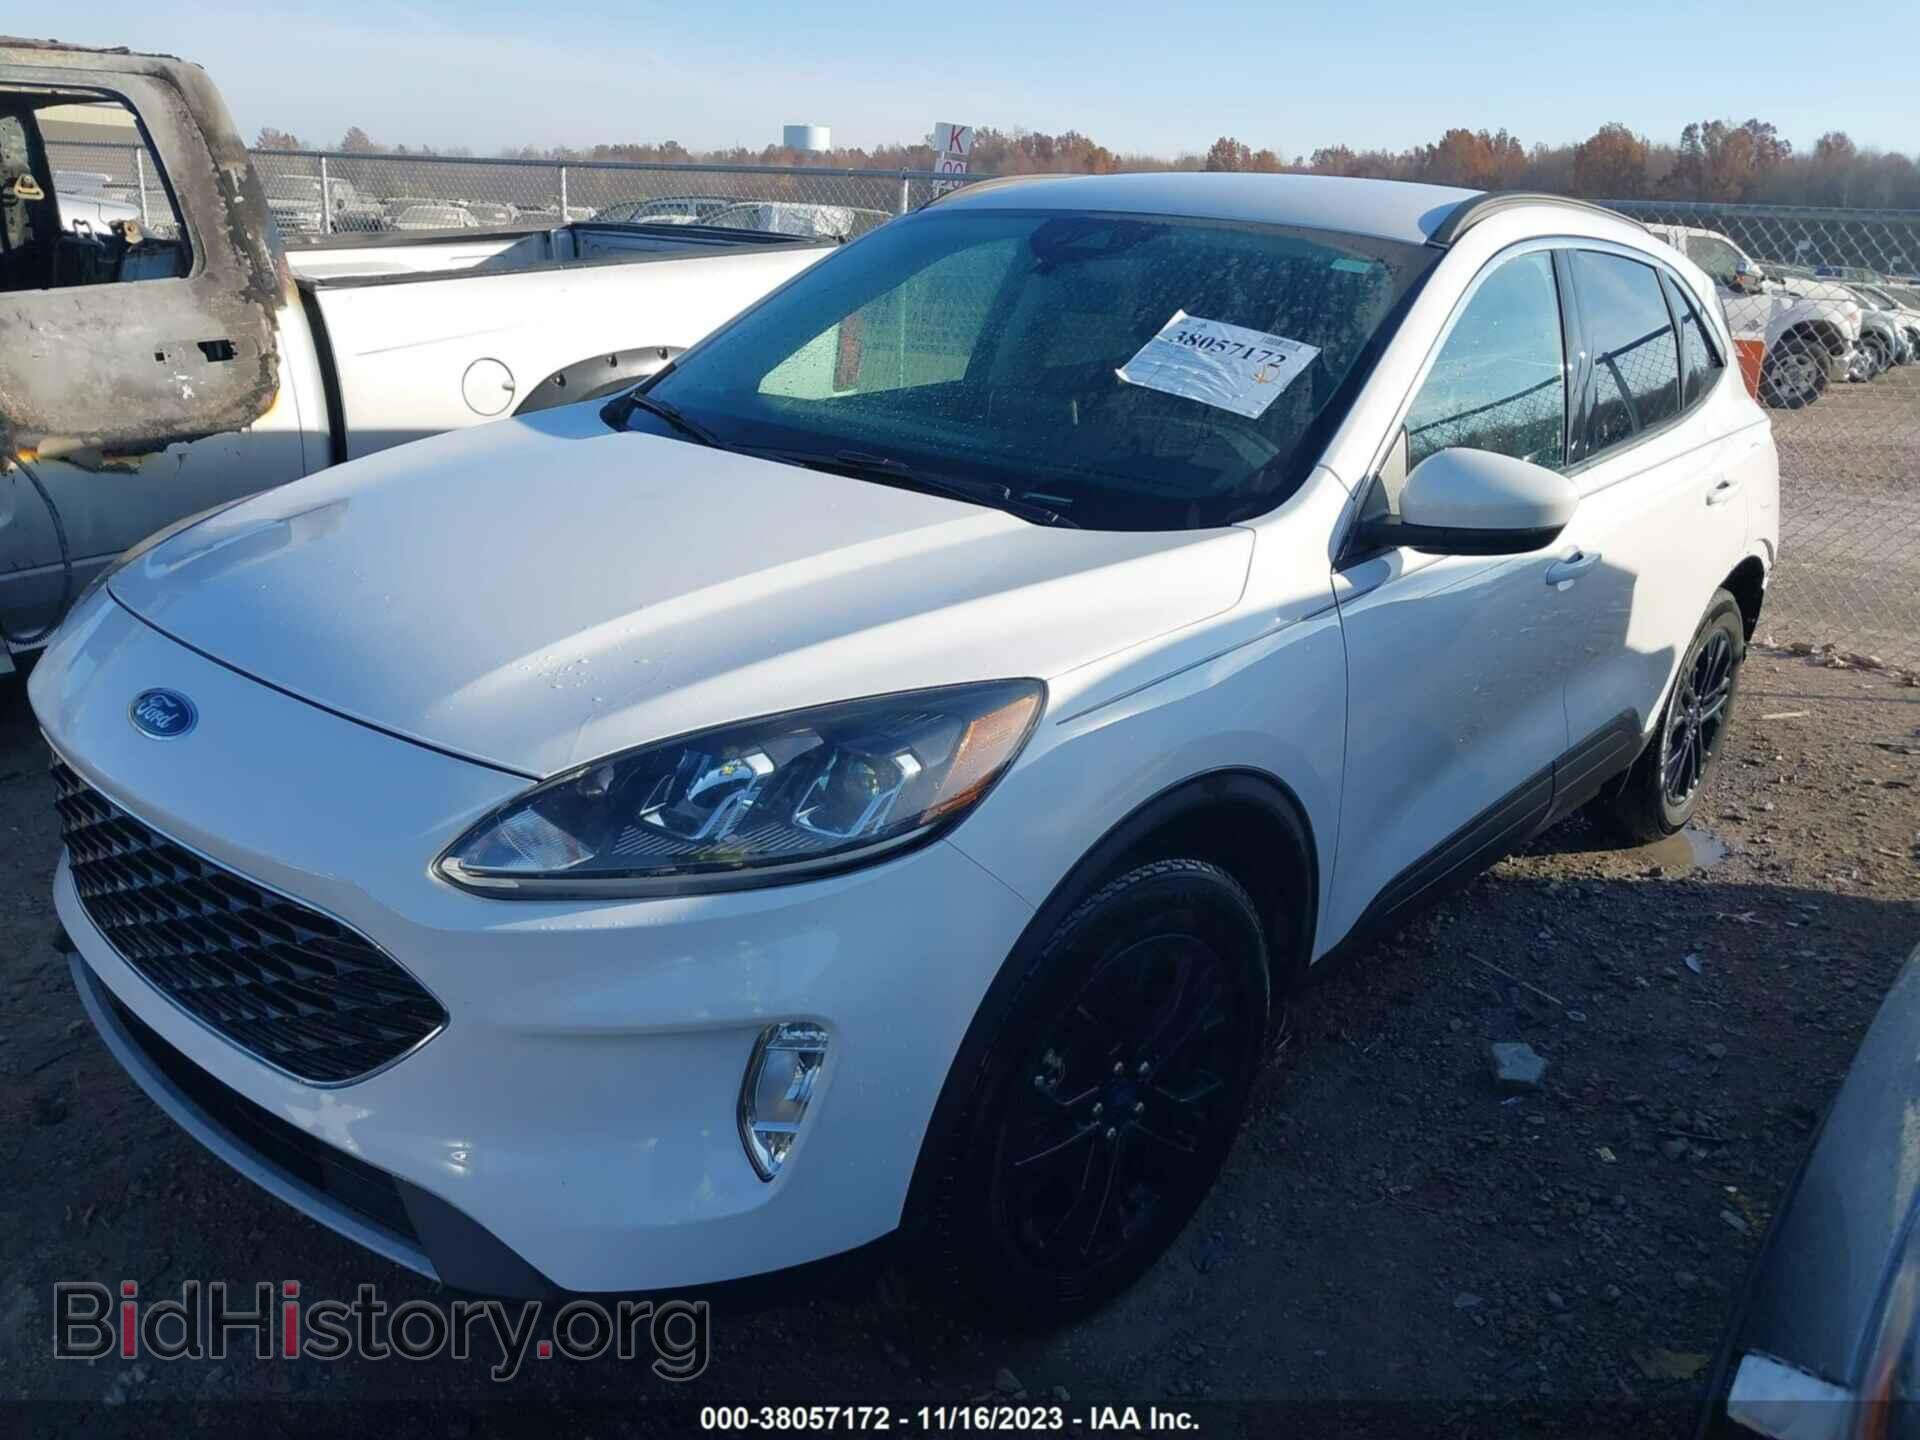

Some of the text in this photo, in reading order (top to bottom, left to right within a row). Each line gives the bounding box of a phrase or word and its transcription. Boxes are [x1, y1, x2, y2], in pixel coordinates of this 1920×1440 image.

[949, 125, 966, 153] K
[1169, 329, 1287, 368] 38057172
[136, 694, 179, 729] Ford
